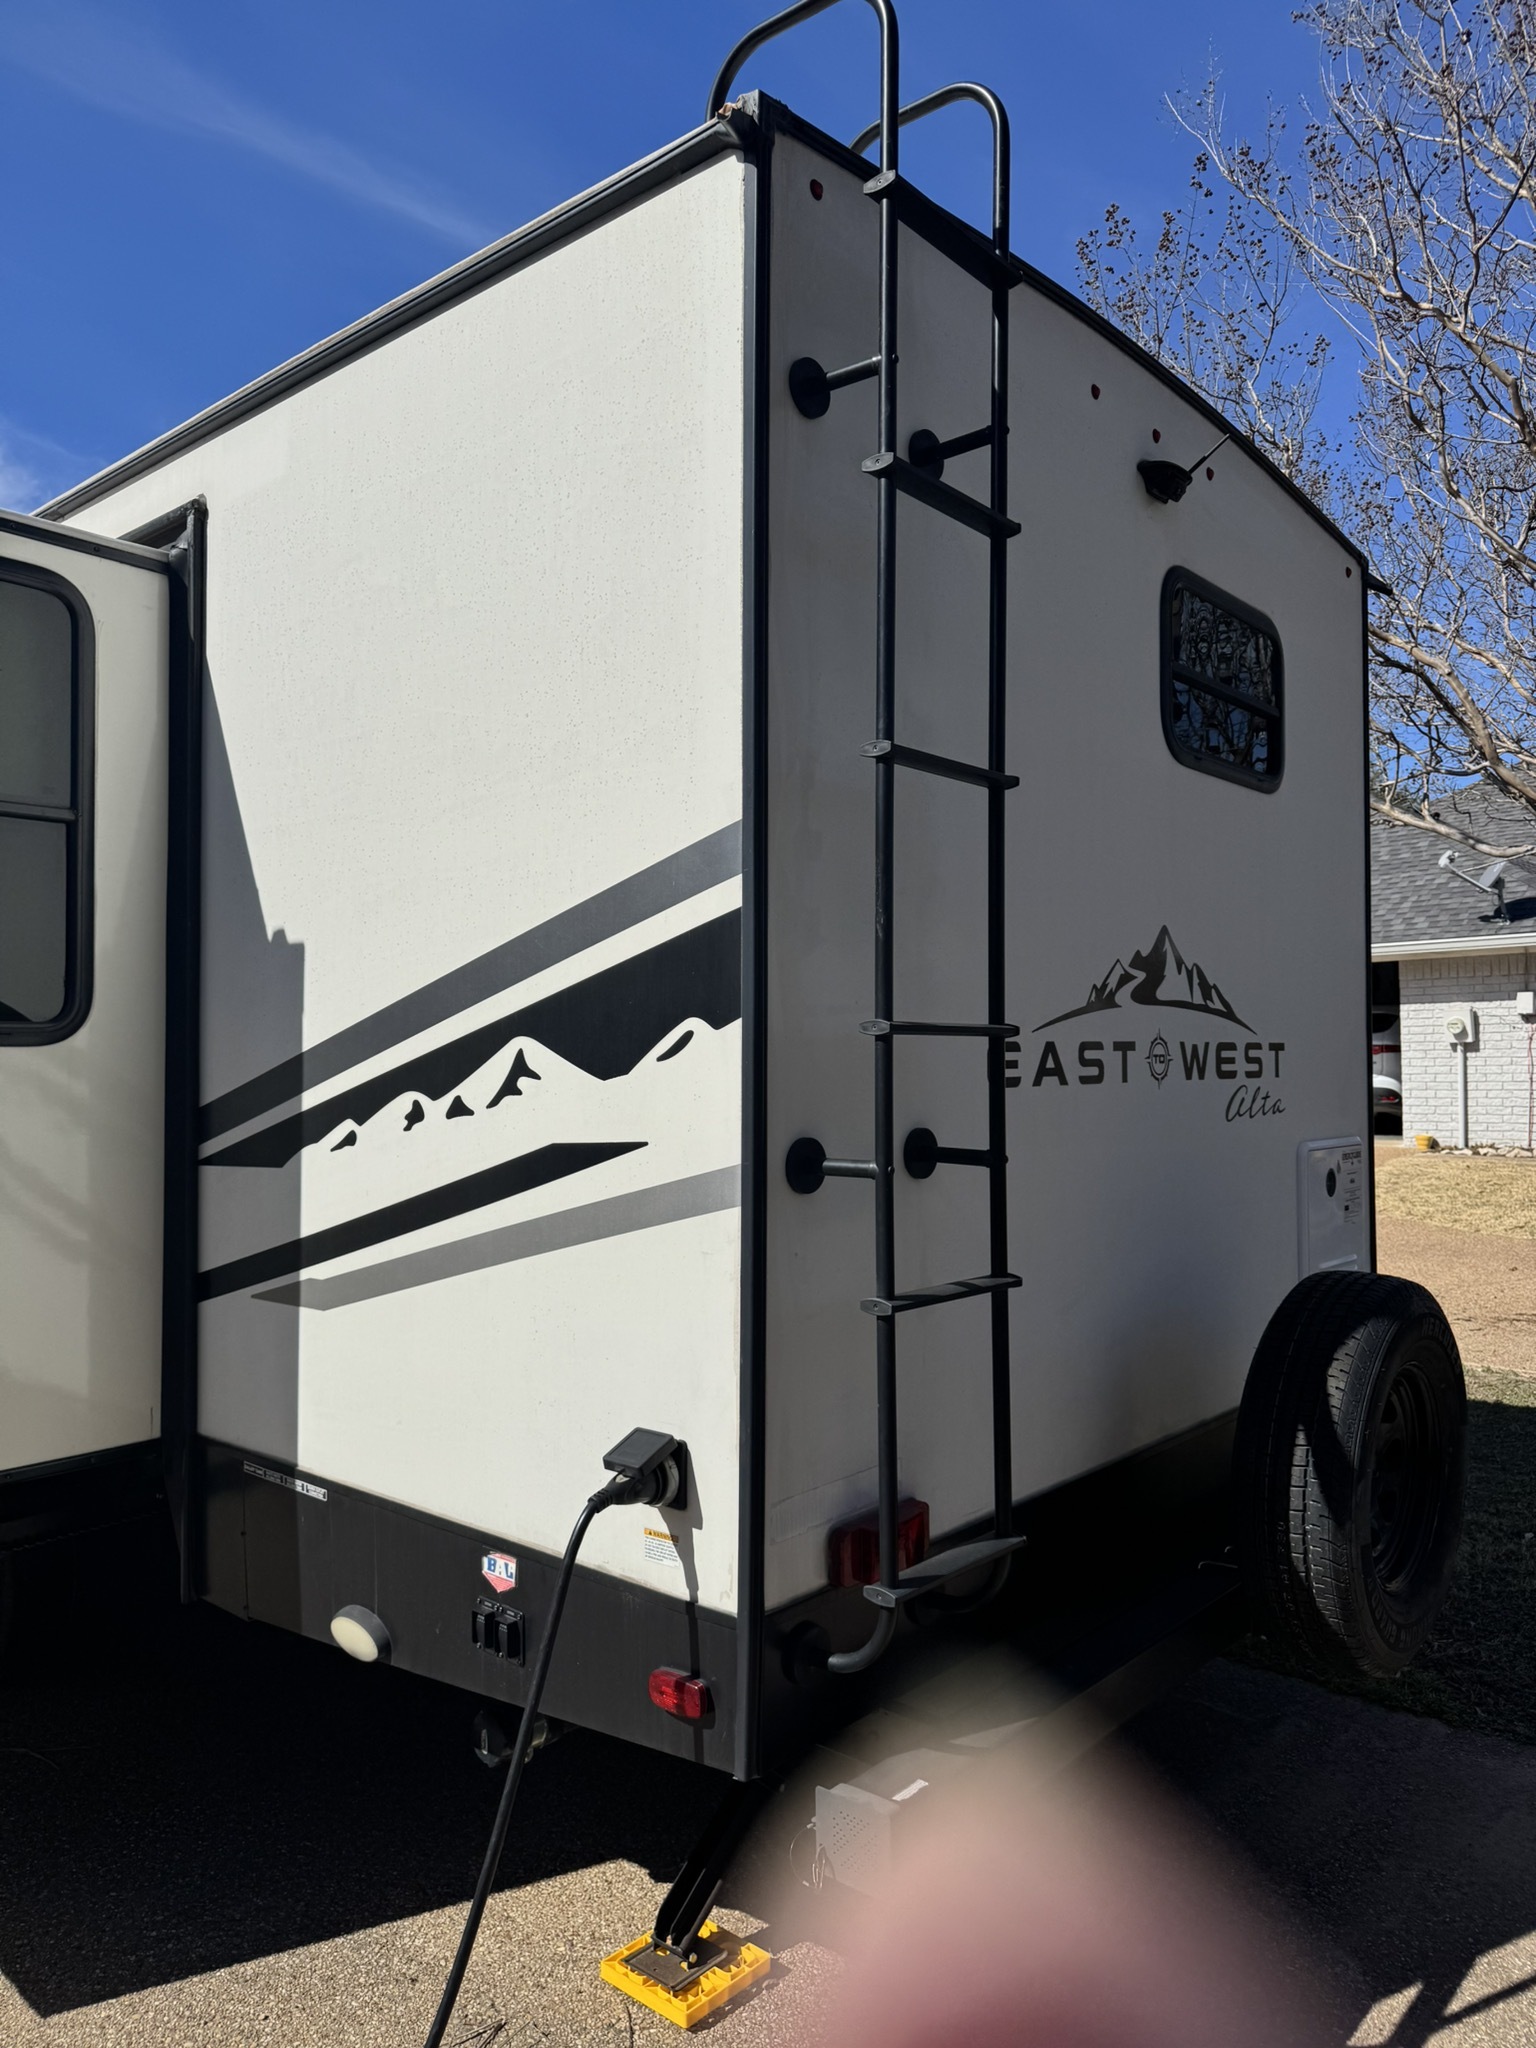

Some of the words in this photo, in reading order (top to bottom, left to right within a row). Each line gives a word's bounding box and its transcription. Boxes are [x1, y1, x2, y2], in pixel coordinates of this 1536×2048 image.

[988, 1041, 1136, 1088] EAST
[1153, 1055, 1165, 1064] TO
[1179, 1041, 1285, 1081] WEST
